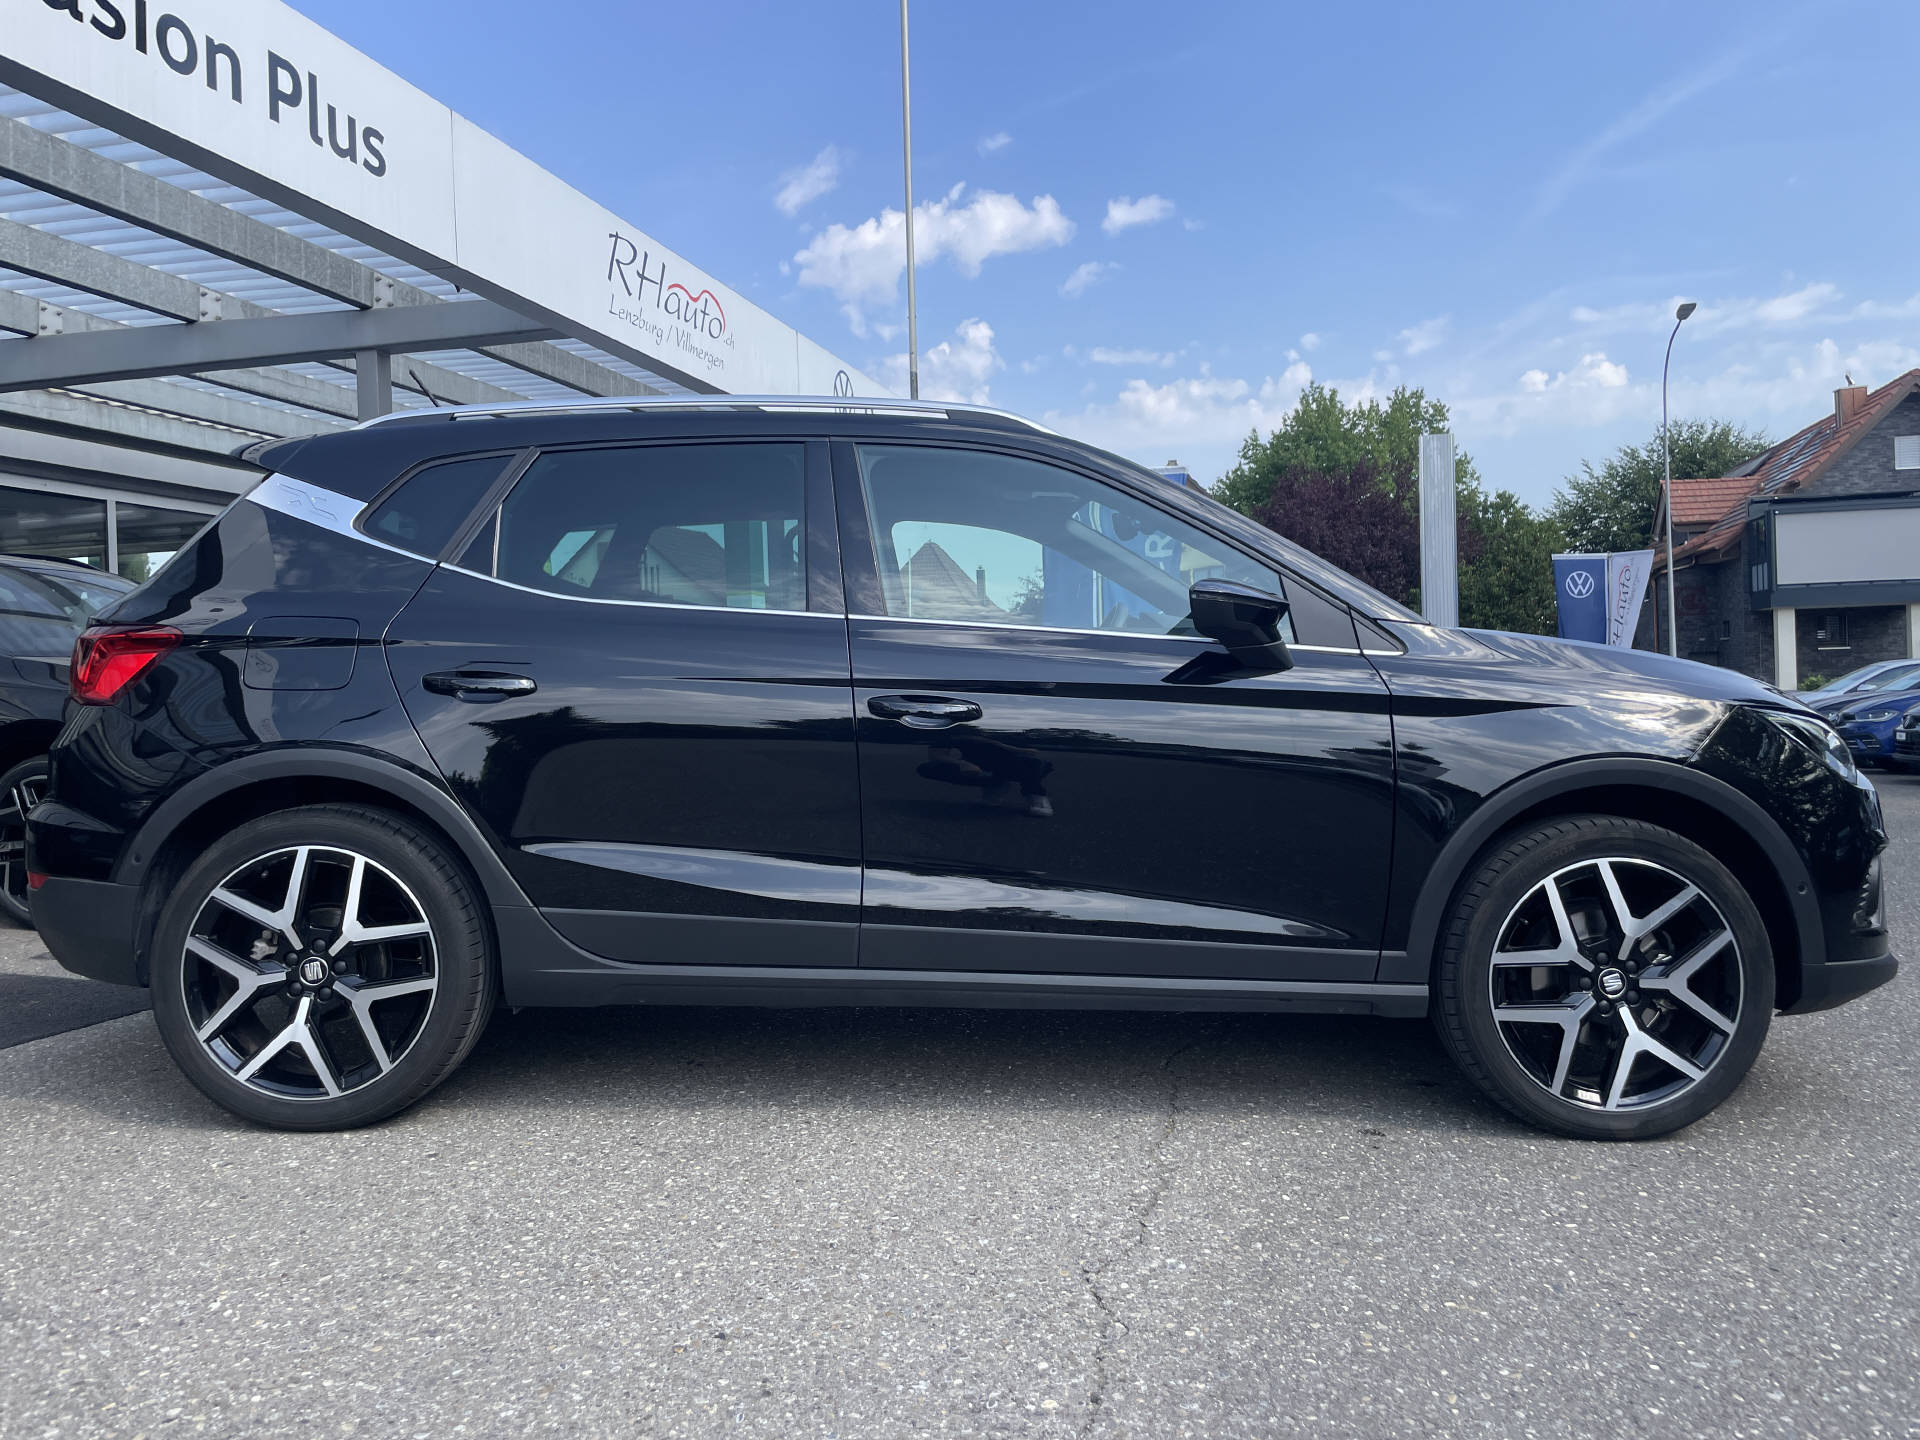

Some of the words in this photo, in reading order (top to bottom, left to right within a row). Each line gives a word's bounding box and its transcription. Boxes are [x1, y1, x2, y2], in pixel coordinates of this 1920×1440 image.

[267, 49, 387, 178] Plus
[609, 294, 664, 346] Lenzburg
[675, 327, 724, 370] Villmergen
